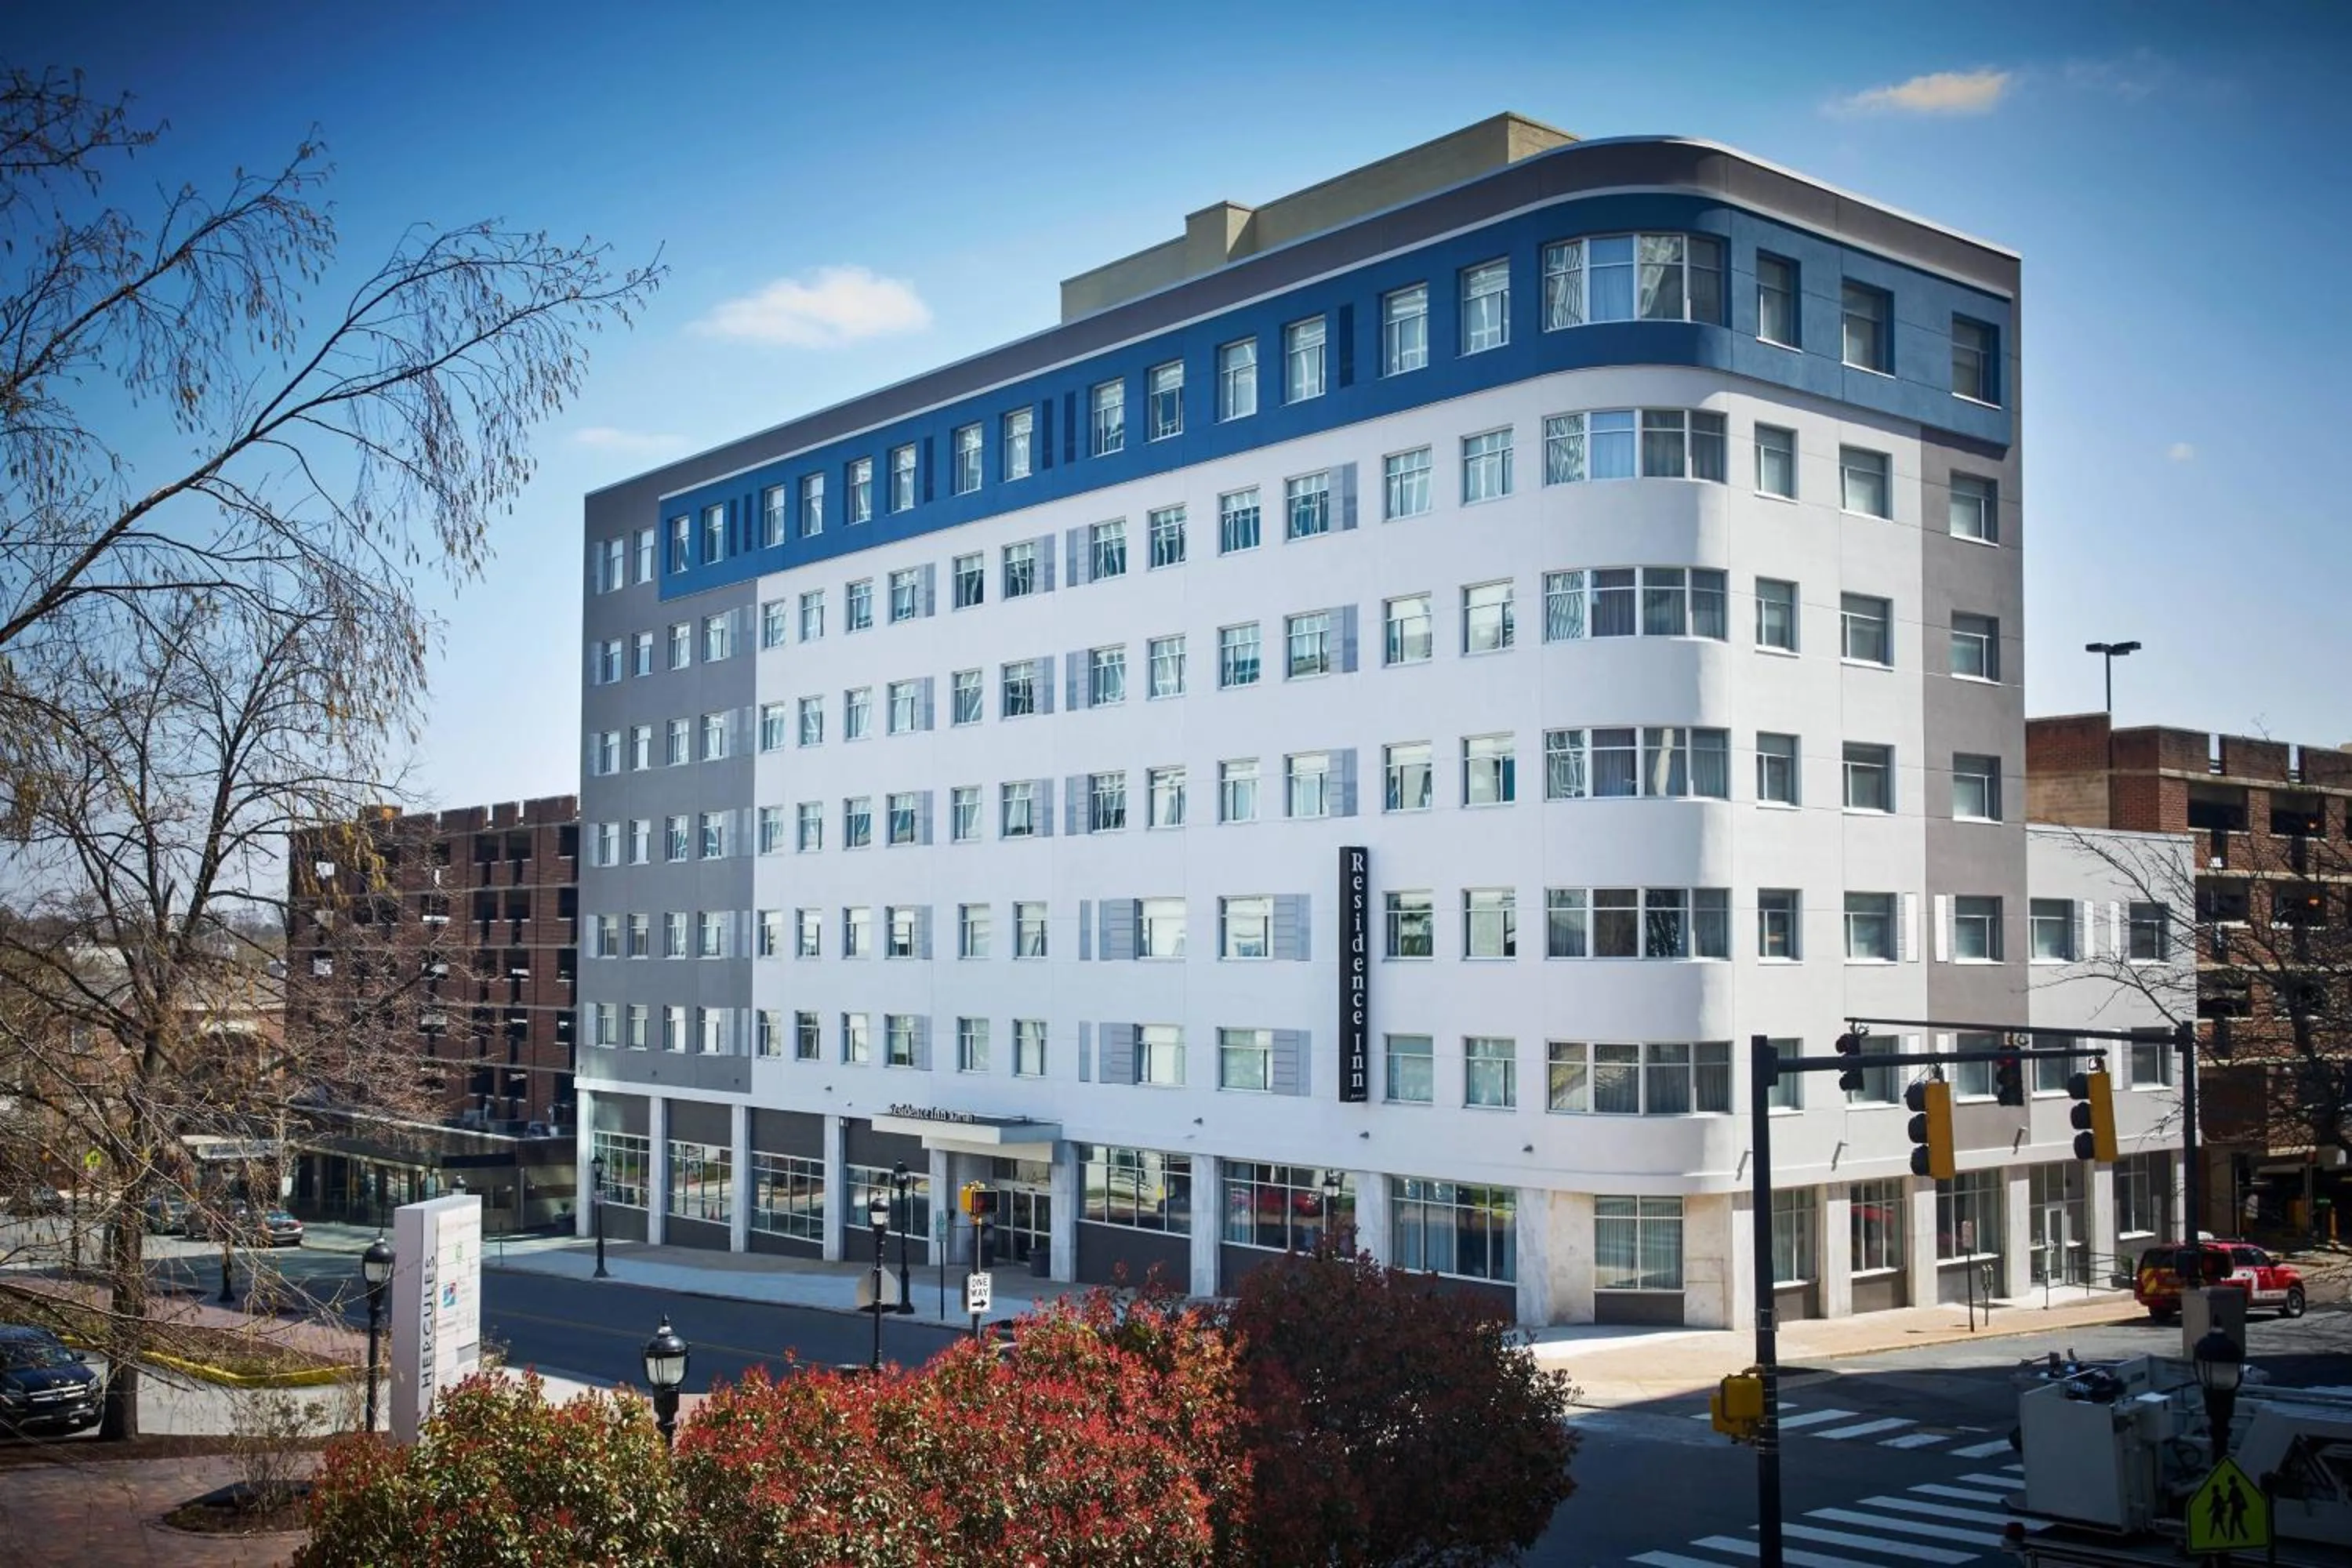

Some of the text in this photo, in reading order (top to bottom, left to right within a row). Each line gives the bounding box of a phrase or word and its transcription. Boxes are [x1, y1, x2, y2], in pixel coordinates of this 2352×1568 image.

[1351, 852, 1364, 1025] Residence
[1351, 1033, 1364, 1087] Inn
[422, 1254, 435, 1390] HERCULES
[972, 1278, 988, 1287] ONE
